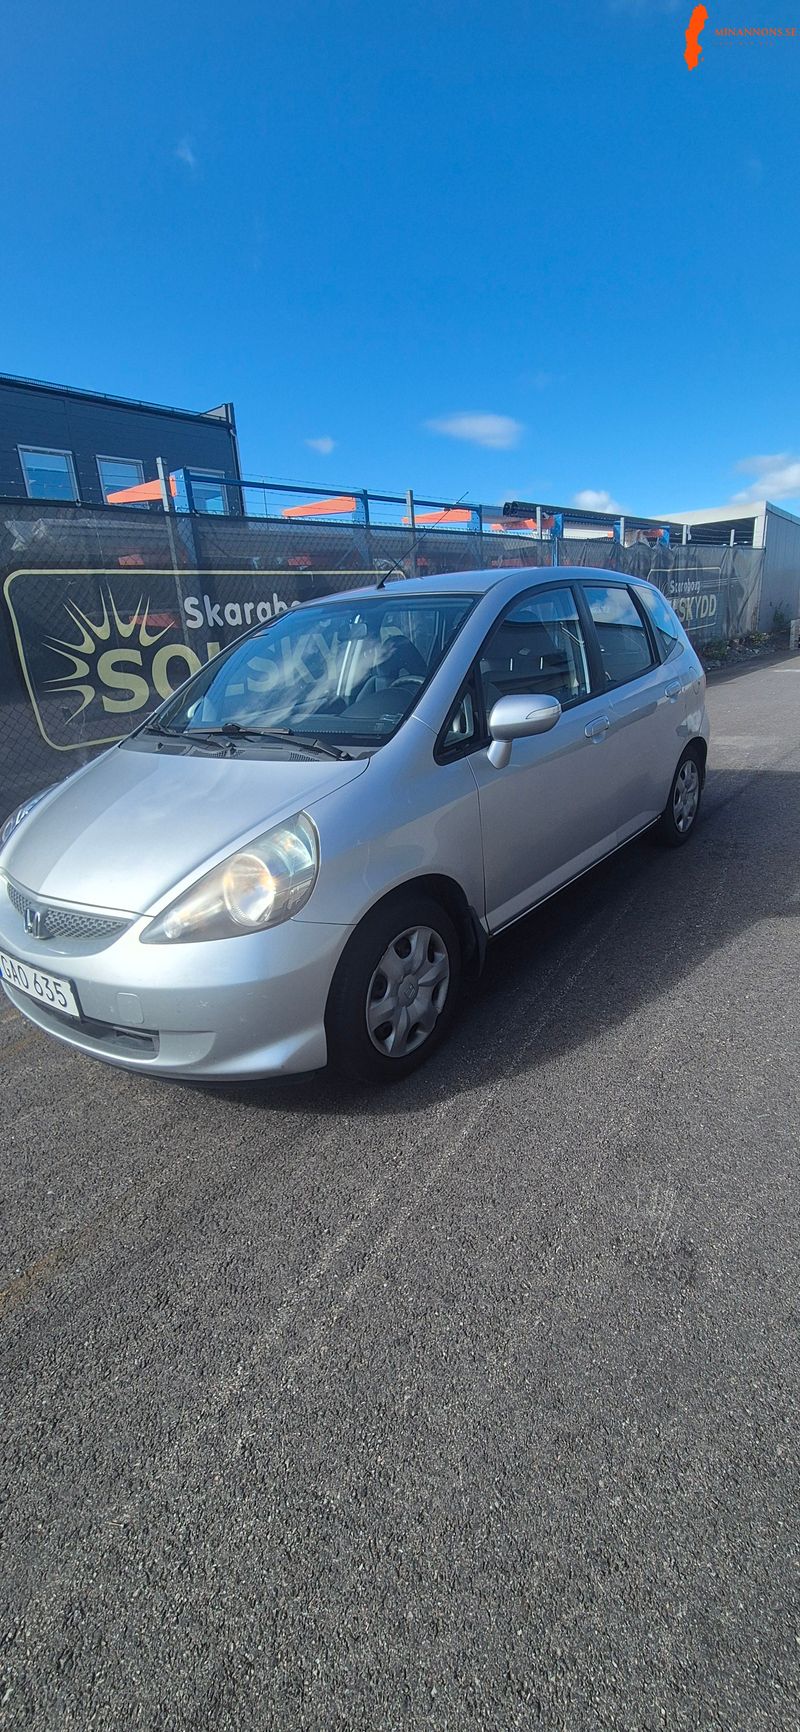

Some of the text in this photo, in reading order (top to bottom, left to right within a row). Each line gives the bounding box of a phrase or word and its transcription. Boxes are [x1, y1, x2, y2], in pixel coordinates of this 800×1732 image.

[183, 592, 310, 629] Skarab
[1, 954, 67, 1007] GAO 635
